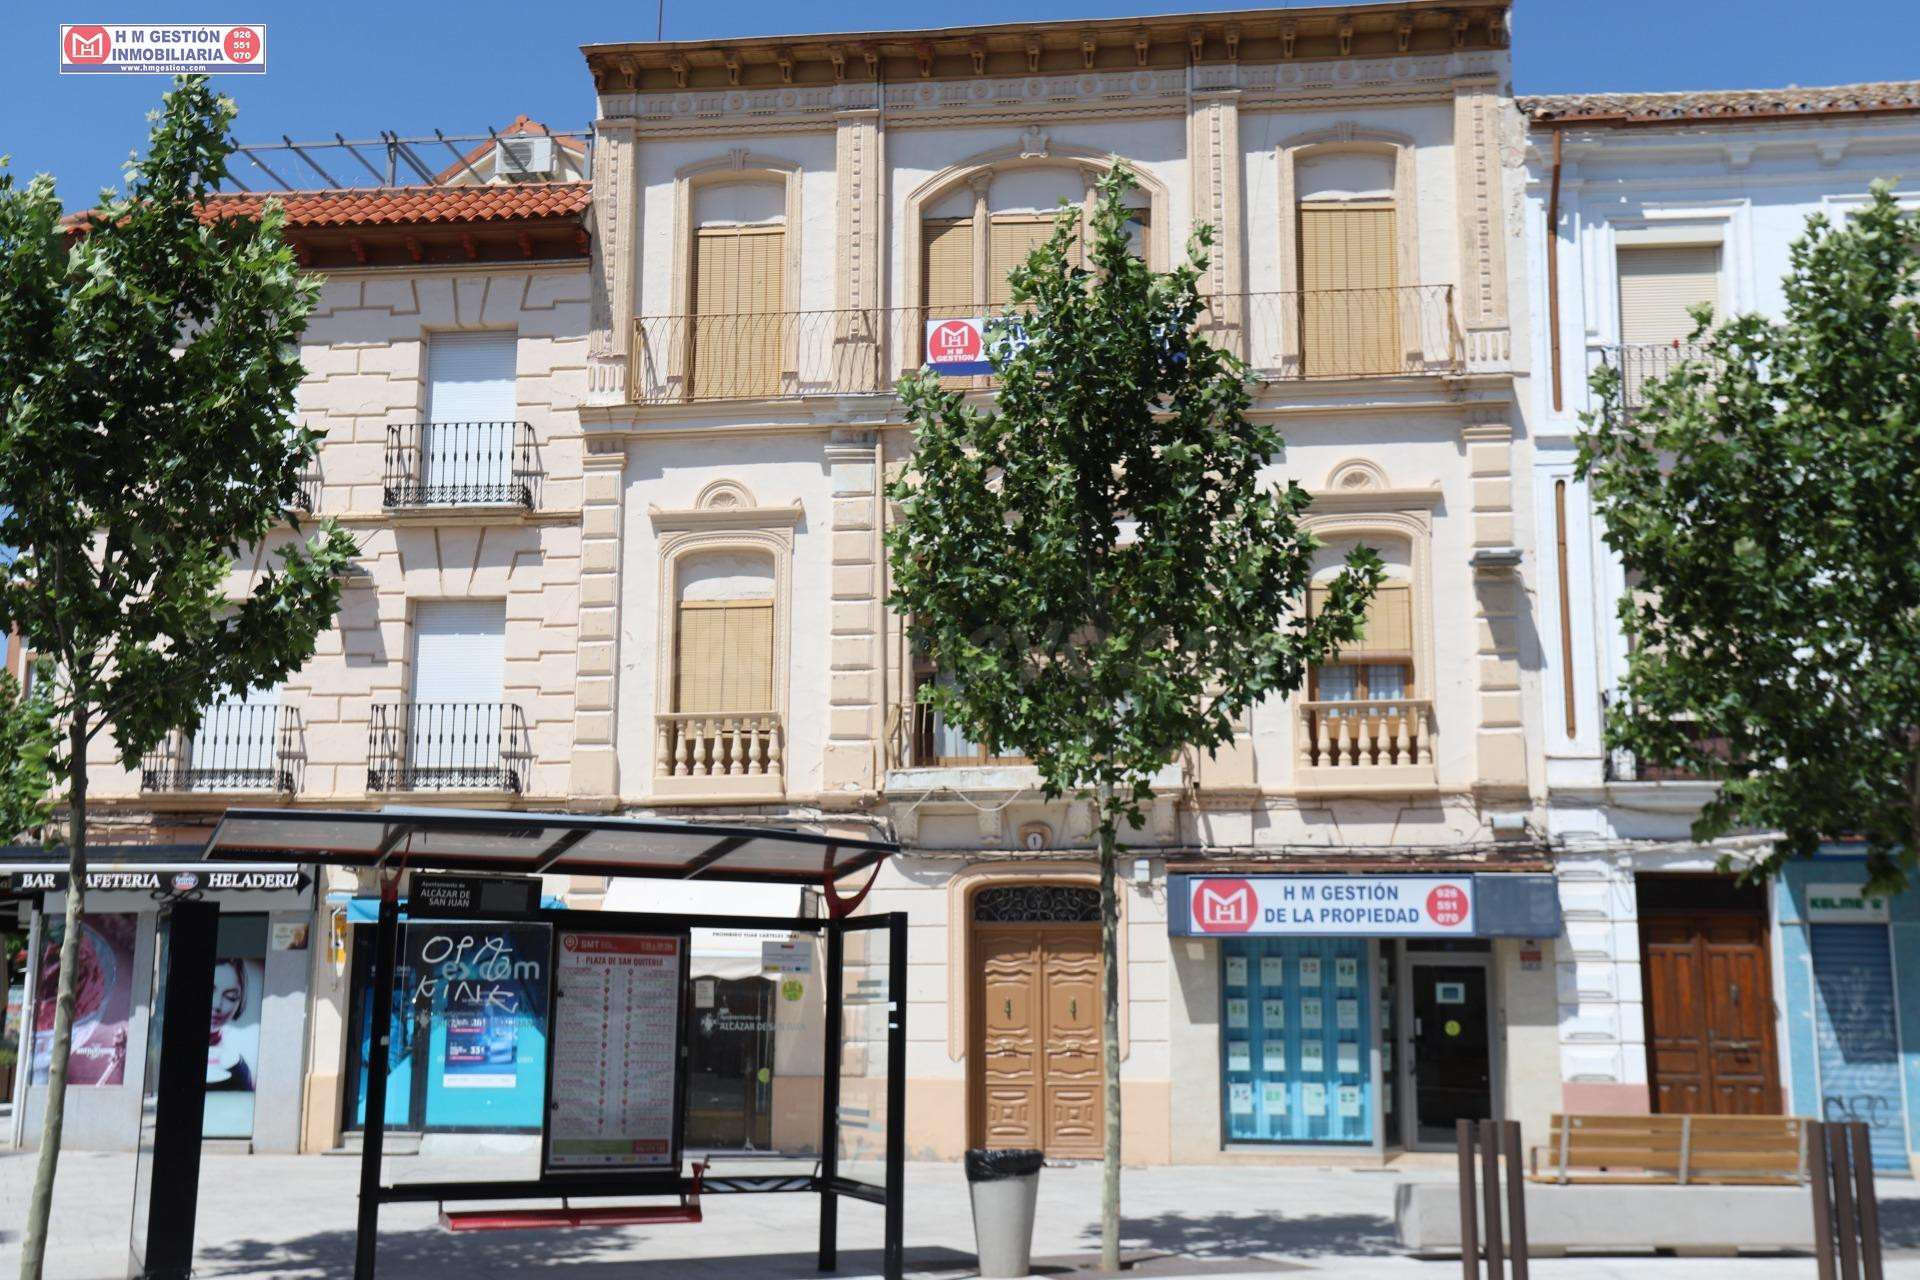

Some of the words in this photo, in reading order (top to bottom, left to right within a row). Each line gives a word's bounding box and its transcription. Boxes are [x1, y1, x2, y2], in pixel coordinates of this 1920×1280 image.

[22, 872, 56, 889] BAR
[84, 872, 160, 888] AFETERIA
[420, 888, 458, 898] ALCÁZAR
[459, 890, 471, 899] DE
[1283, 886, 1295, 901] H
[1301, 886, 1314, 901] M
[1321, 881, 1398, 901] GESTIÓN
[1436, 888, 1458, 898] 926
[429, 898, 446, 906] SAN
[447, 898, 470, 907] JUAN
[1437, 900, 1458, 910] 551
[1264, 908, 1287, 924] DE
[1292, 908, 1314, 924] LA
[1319, 908, 1420, 924] PROPIEDAD
[1437, 913, 1459, 923] 070
